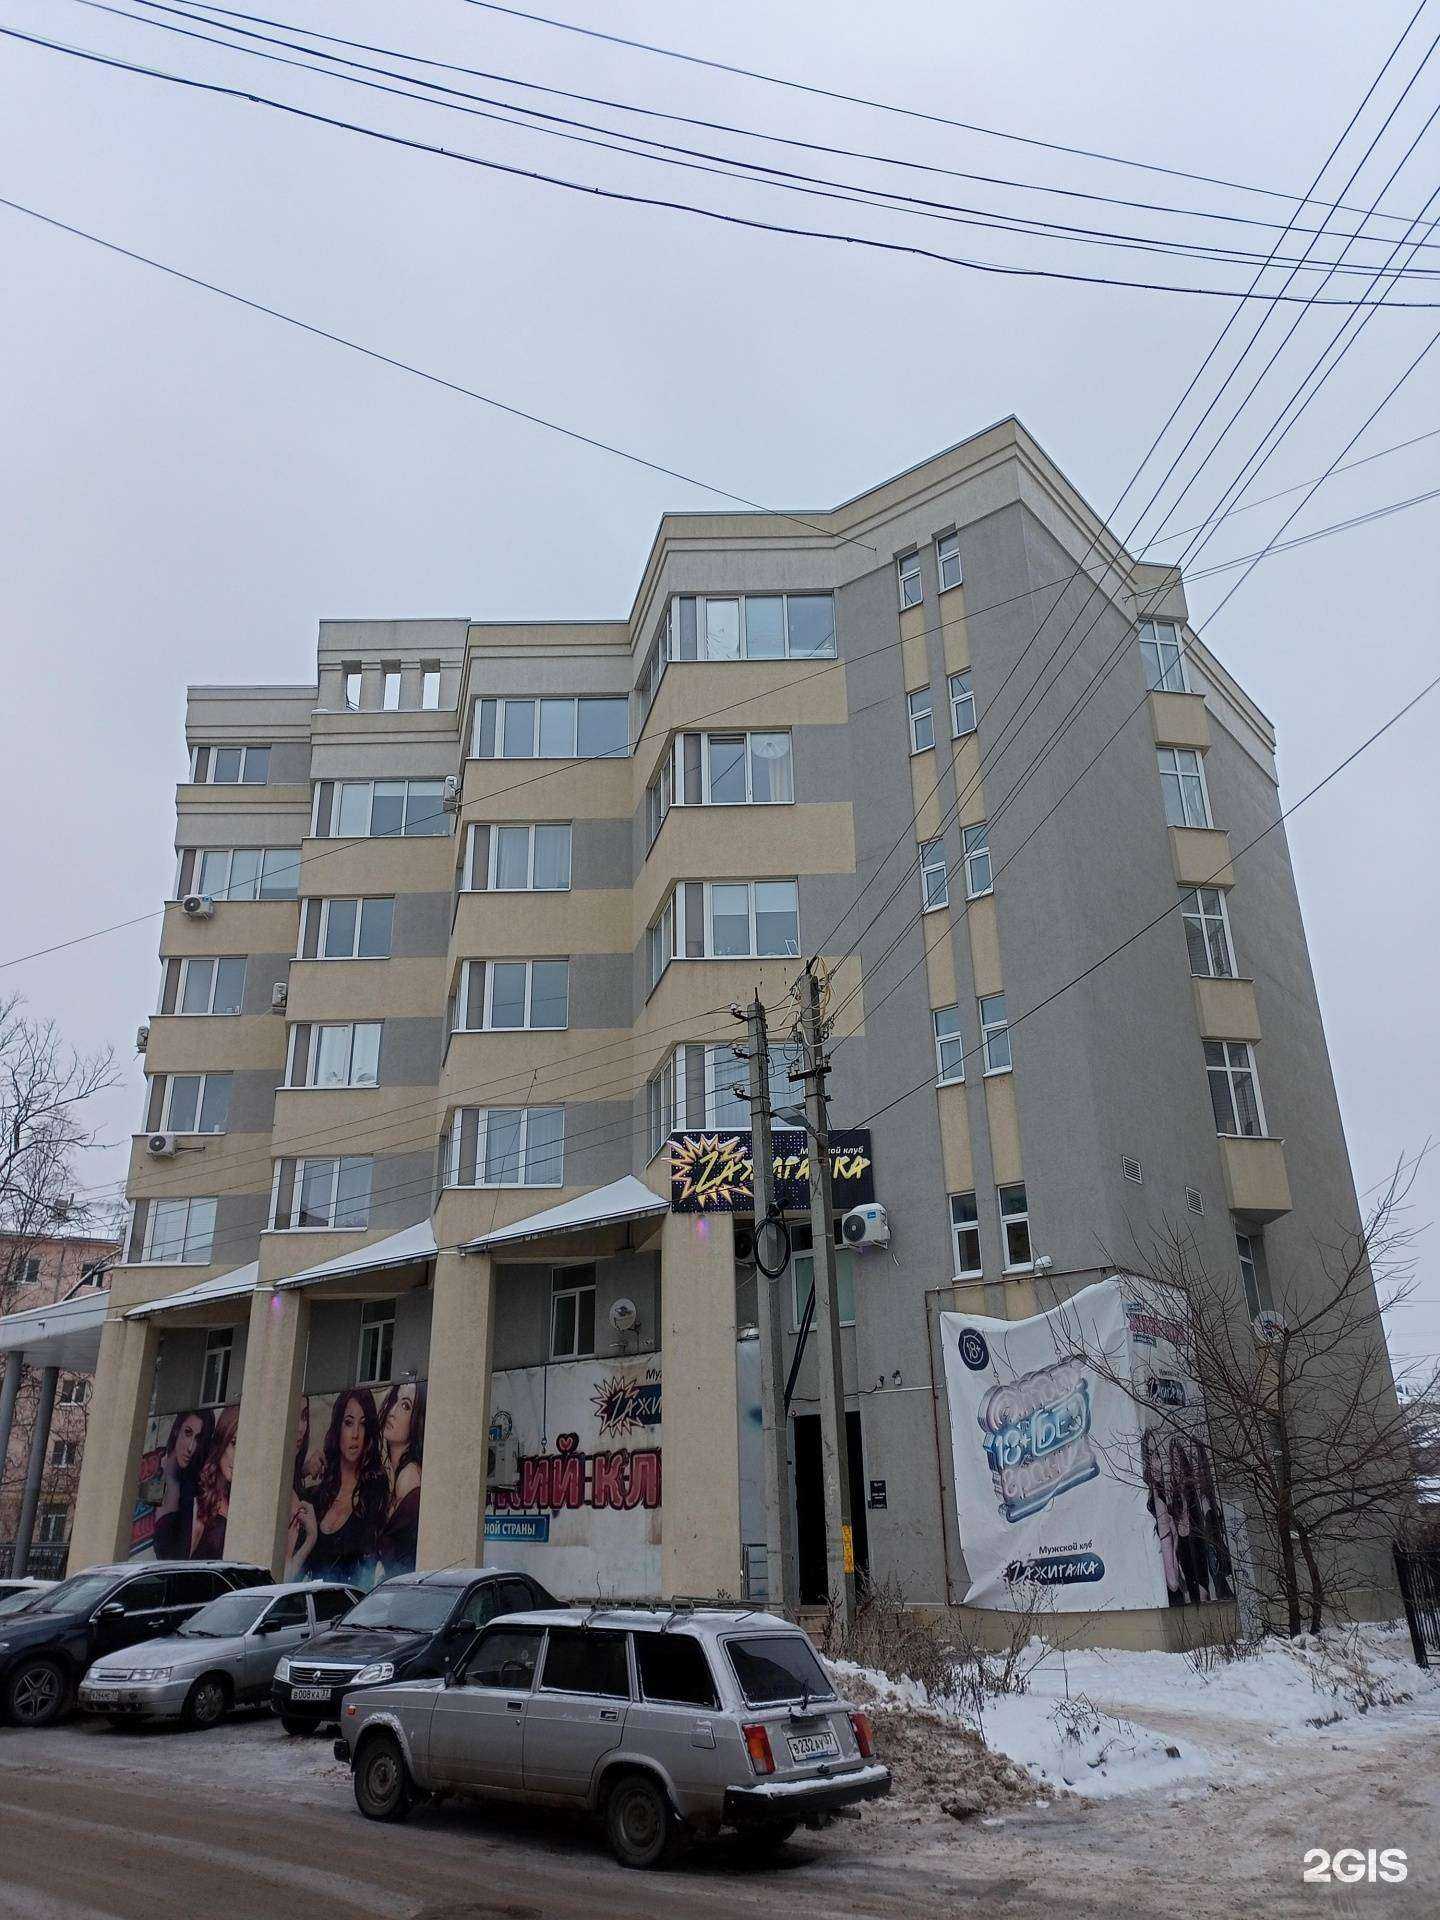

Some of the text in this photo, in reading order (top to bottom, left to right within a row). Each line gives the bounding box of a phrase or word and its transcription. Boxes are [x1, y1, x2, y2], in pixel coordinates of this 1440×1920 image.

[843, 1145, 864, 1155] клуб
[966, 1341, 981, 1360] 18+
[502, 1521, 536, 1536] СТРАНЫ
[1038, 1542, 1078, 1555] Мужской
